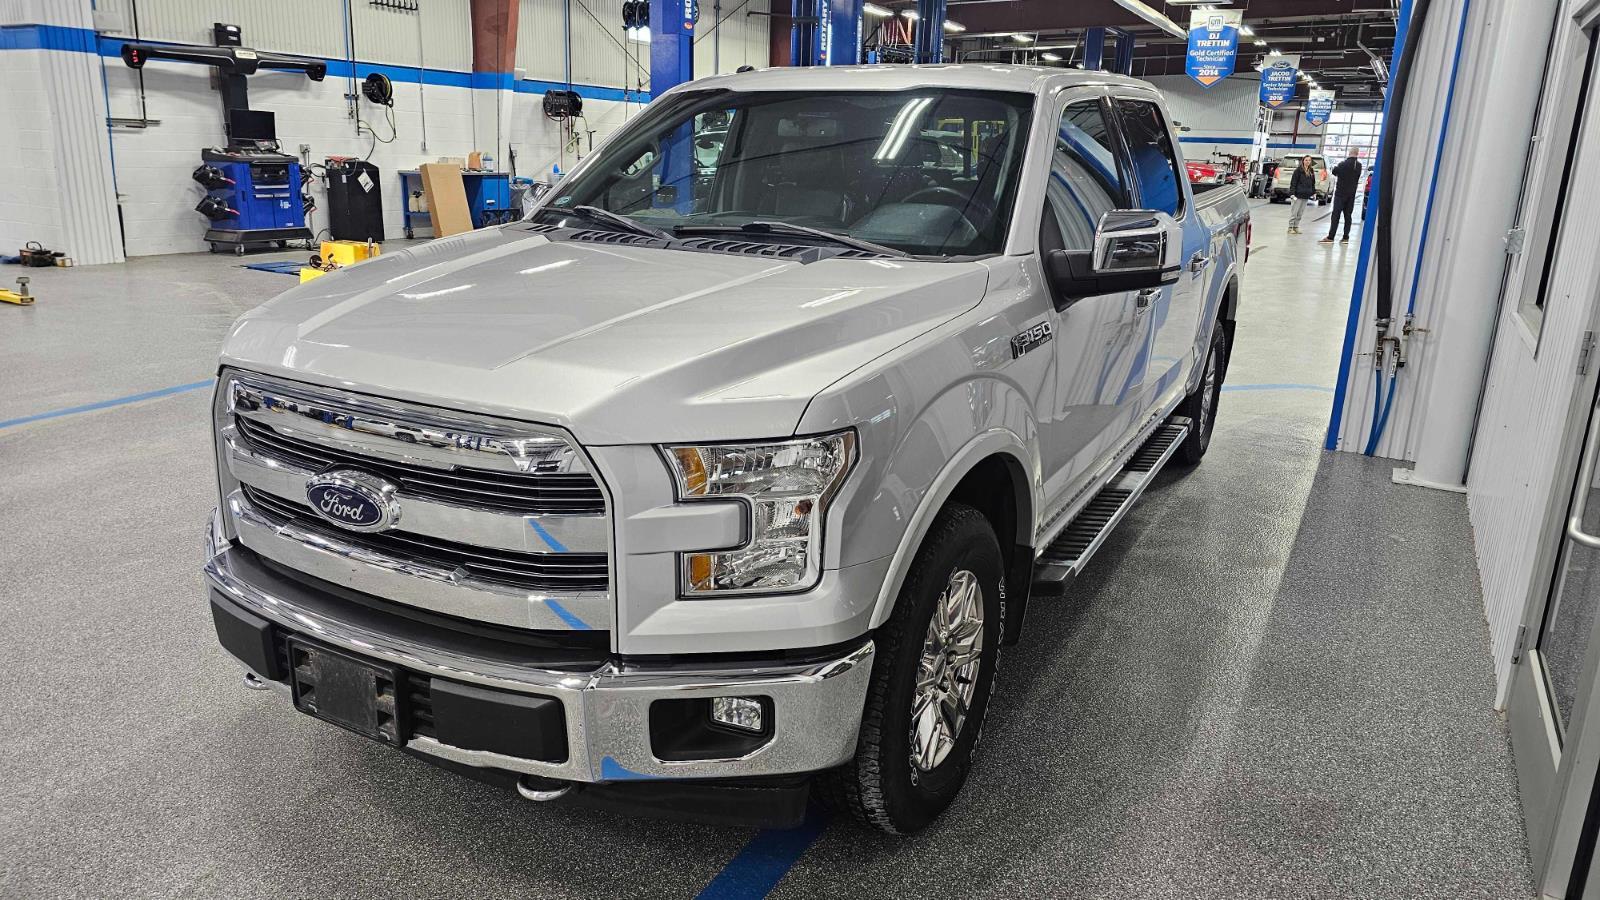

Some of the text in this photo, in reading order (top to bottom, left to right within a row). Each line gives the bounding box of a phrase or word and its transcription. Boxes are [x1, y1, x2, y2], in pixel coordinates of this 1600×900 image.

[820, 0, 828, 51] ROTARY
[1190, 49, 1205, 57] Gold
[320, 488, 364, 520] Ford
